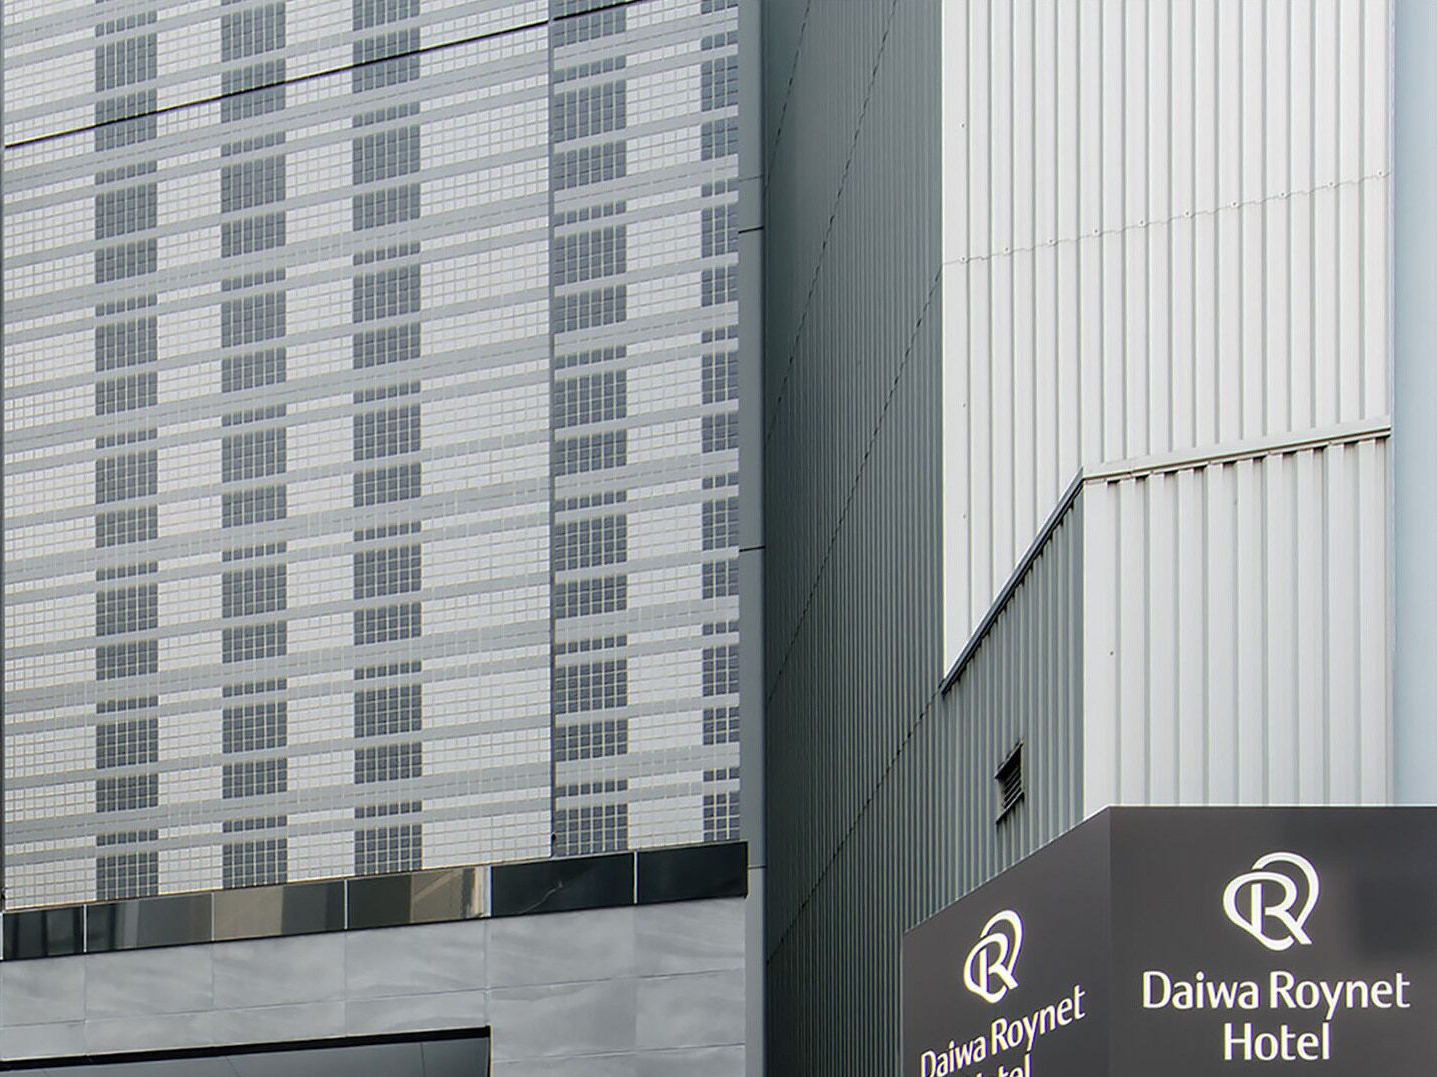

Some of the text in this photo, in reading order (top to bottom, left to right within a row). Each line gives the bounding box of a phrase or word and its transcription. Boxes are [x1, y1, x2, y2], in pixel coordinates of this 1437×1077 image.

[991, 984, 1086, 1056] Roynet
[1143, 971, 1411, 1020] Daiwa Roynet
[1224, 1022, 1330, 1061] Hotel
